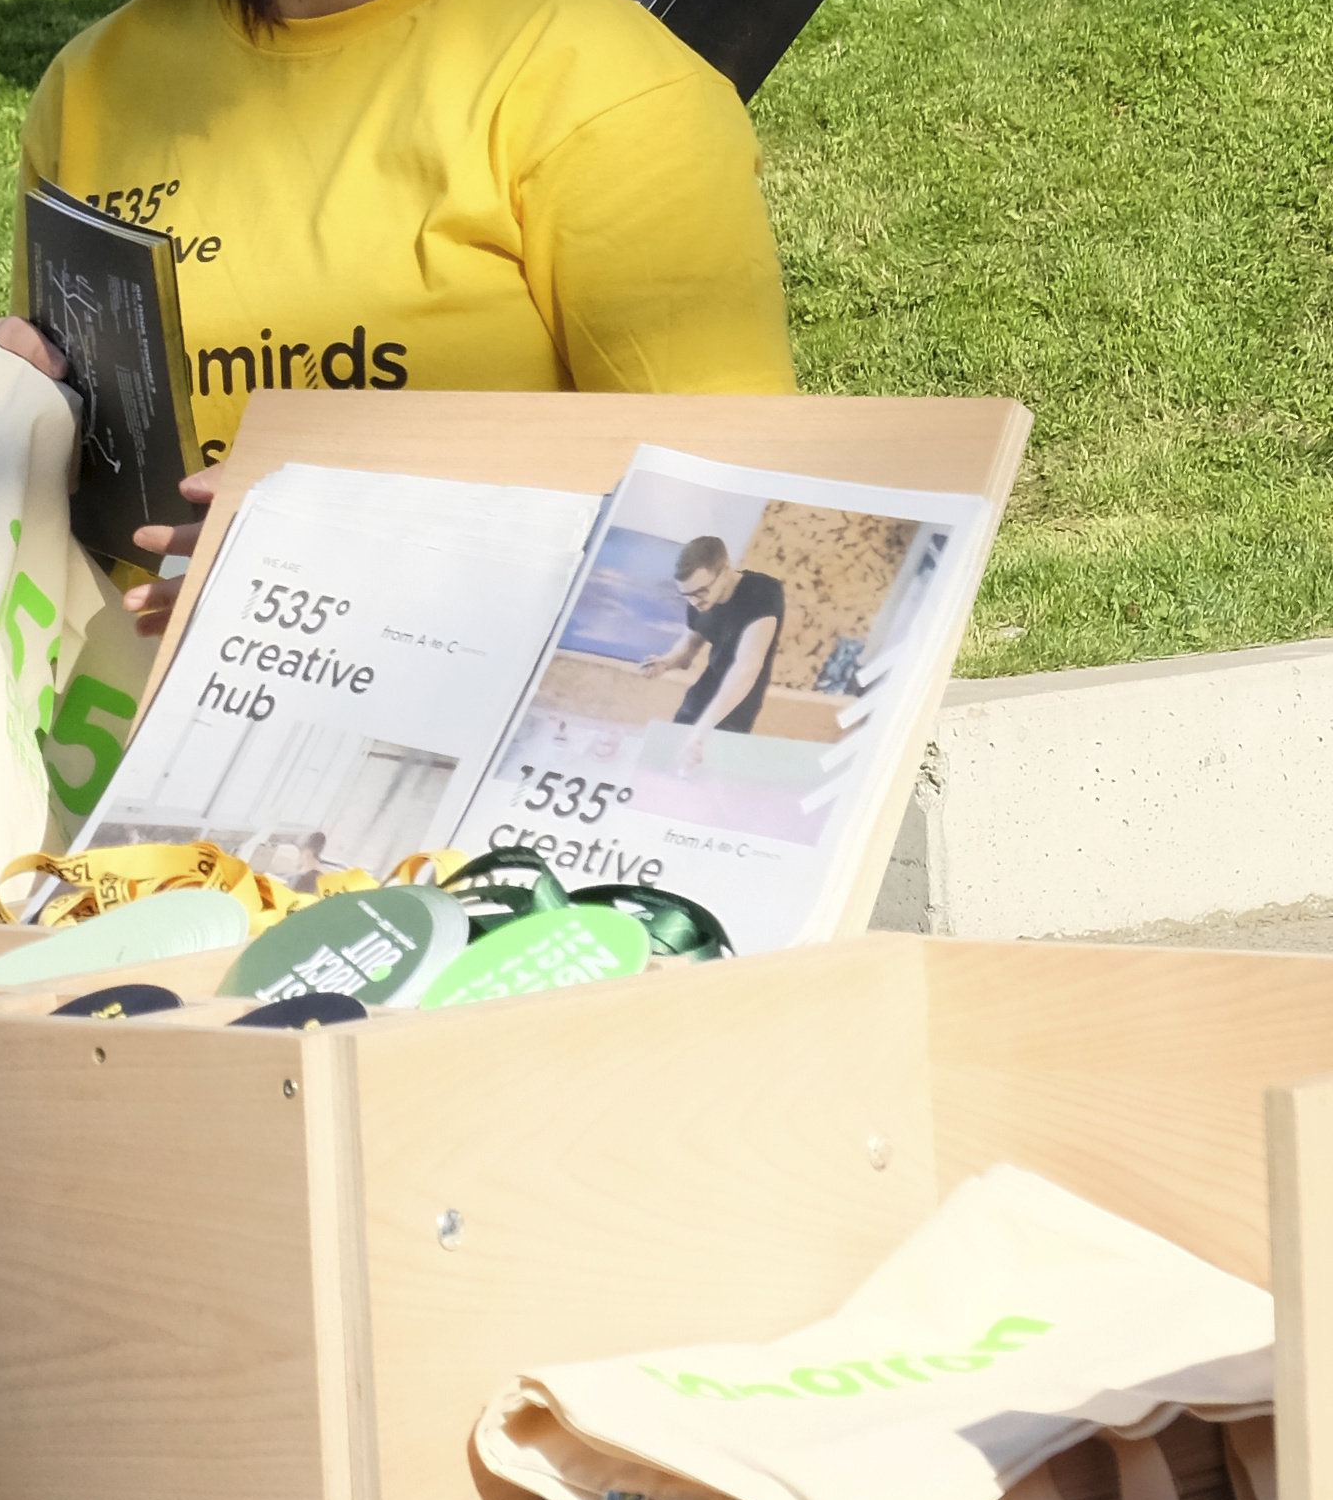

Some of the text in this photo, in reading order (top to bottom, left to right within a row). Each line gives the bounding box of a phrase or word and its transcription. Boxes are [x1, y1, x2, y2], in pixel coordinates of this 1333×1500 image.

[185, 325, 408, 396] minds
[220, 635, 374, 694] creative
[197, 672, 275, 722] hub
[489, 823, 664, 887] creative
